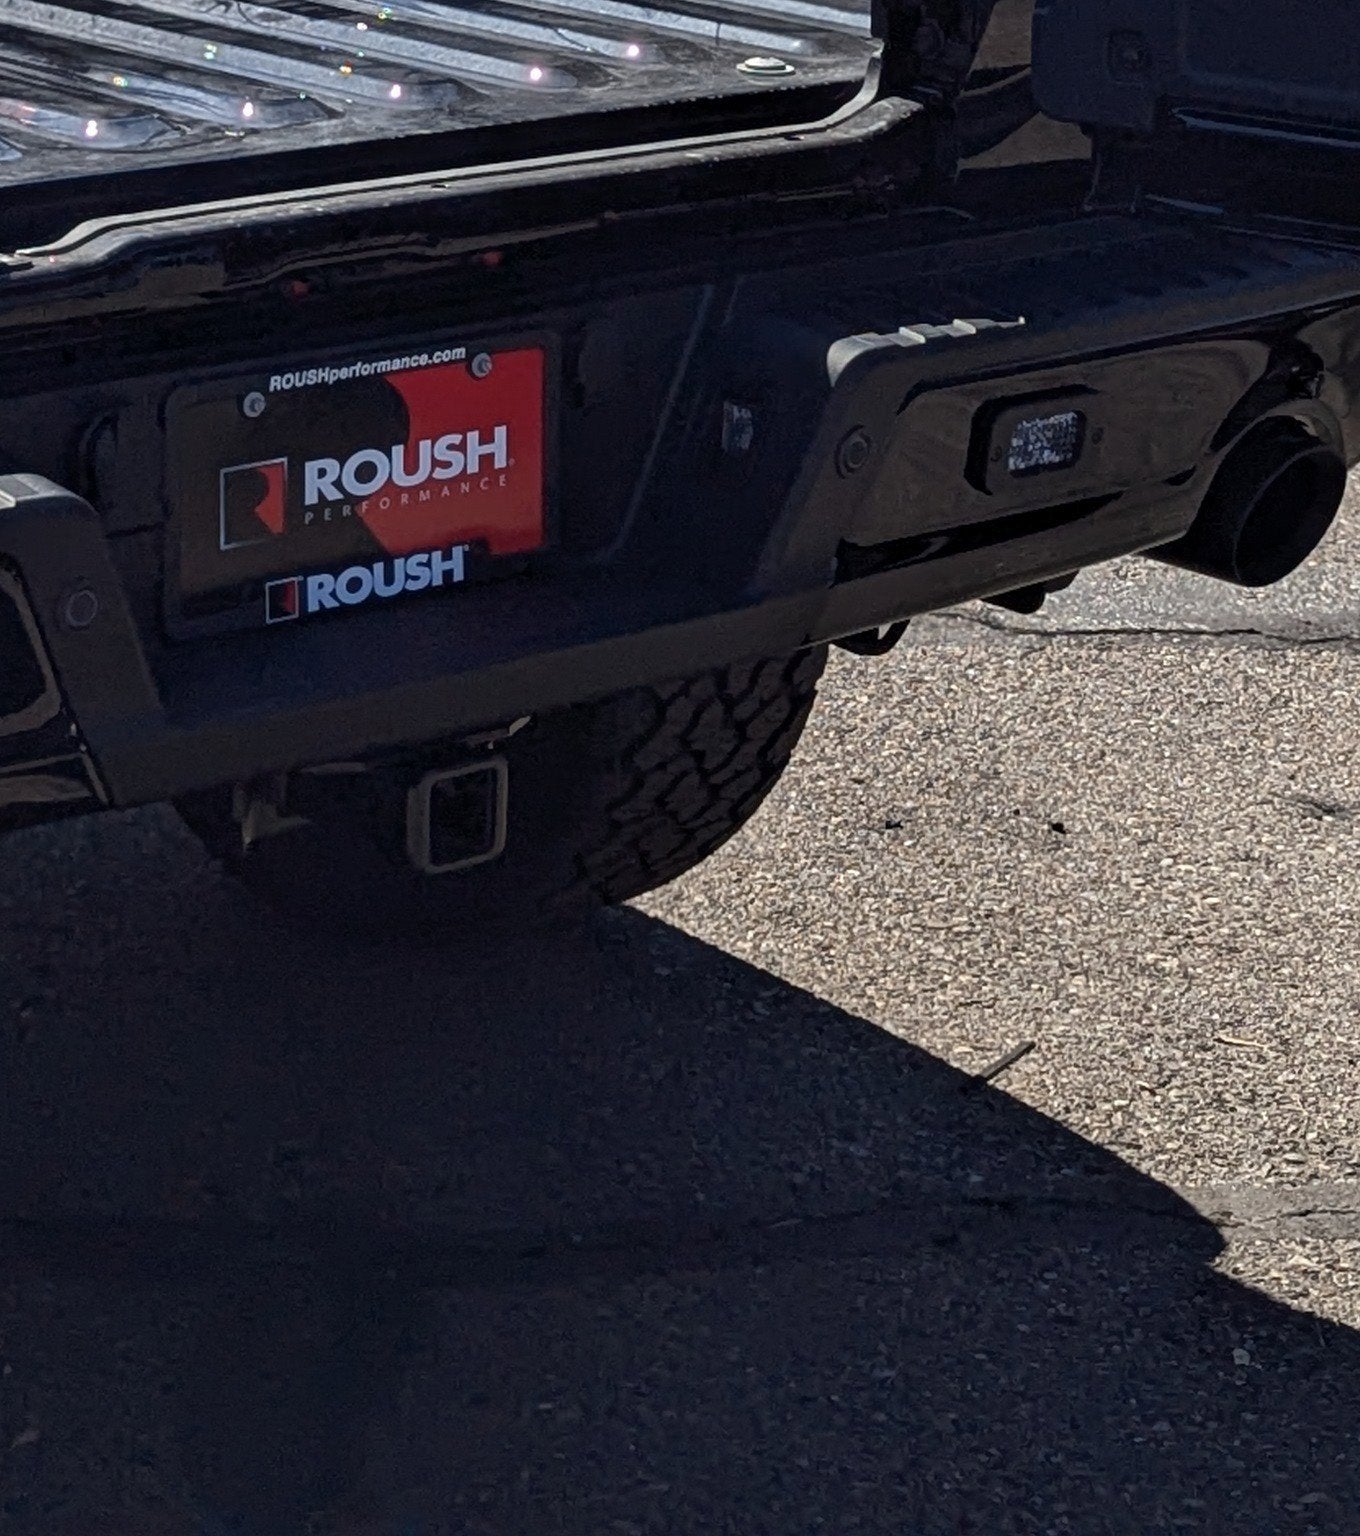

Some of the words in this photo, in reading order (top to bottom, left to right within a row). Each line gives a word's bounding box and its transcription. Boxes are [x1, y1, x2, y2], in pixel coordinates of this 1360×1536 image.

[269, 345, 467, 393] ROUSHperformance.com
[303, 424, 509, 506] ROUSH
[303, 474, 509, 526] PERFORMANCE
[306, 544, 466, 613] ROUSH
